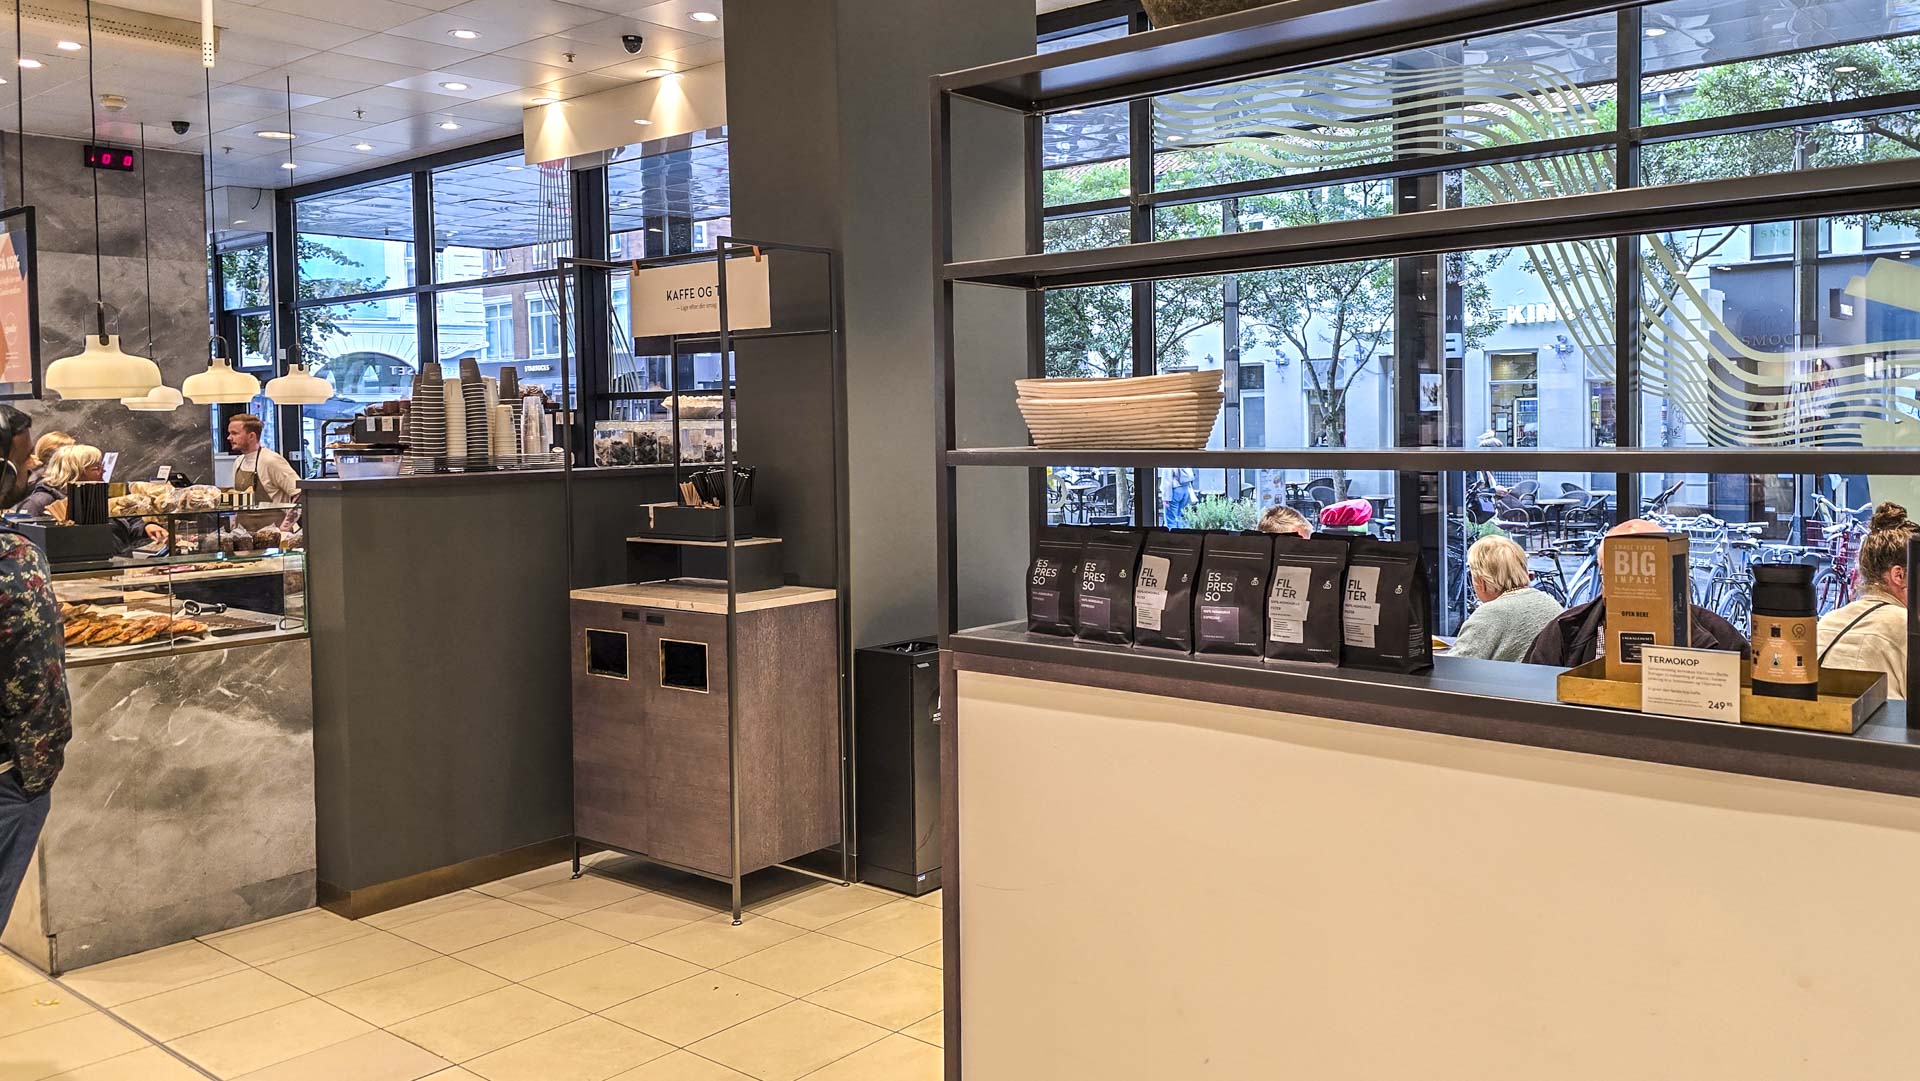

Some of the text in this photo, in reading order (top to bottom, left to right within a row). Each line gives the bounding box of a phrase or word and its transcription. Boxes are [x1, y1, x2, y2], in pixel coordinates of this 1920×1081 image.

[666, 287, 695, 301] KAFFE
[697, 285, 713, 298] OG
[1037, 559, 1048, 568] ES
[1084, 562, 1097, 571] ES
[1614, 550, 1656, 577] BIG
[1034, 567, 1057, 578] PRES
[1083, 571, 1106, 583] PRES
[1142, 567, 1154, 578] FIL
[1208, 572, 1221, 582] ES
[1032, 576, 1046, 586] SO
[1140, 576, 1157, 588] TER
[1276, 578, 1292, 589] FIL
[1348, 579, 1362, 590] FIL
[1614, 575, 1656, 585] IMPACT
[1082, 581, 1095, 591] SO
[1206, 582, 1233, 593] PRES
[1204, 591, 1221, 602] SO
[1275, 588, 1297, 599] TER
[1347, 590, 1367, 601] TER
[1647, 655, 1700, 667] TERMOKOP
[1707, 700, 1726, 710] 249
